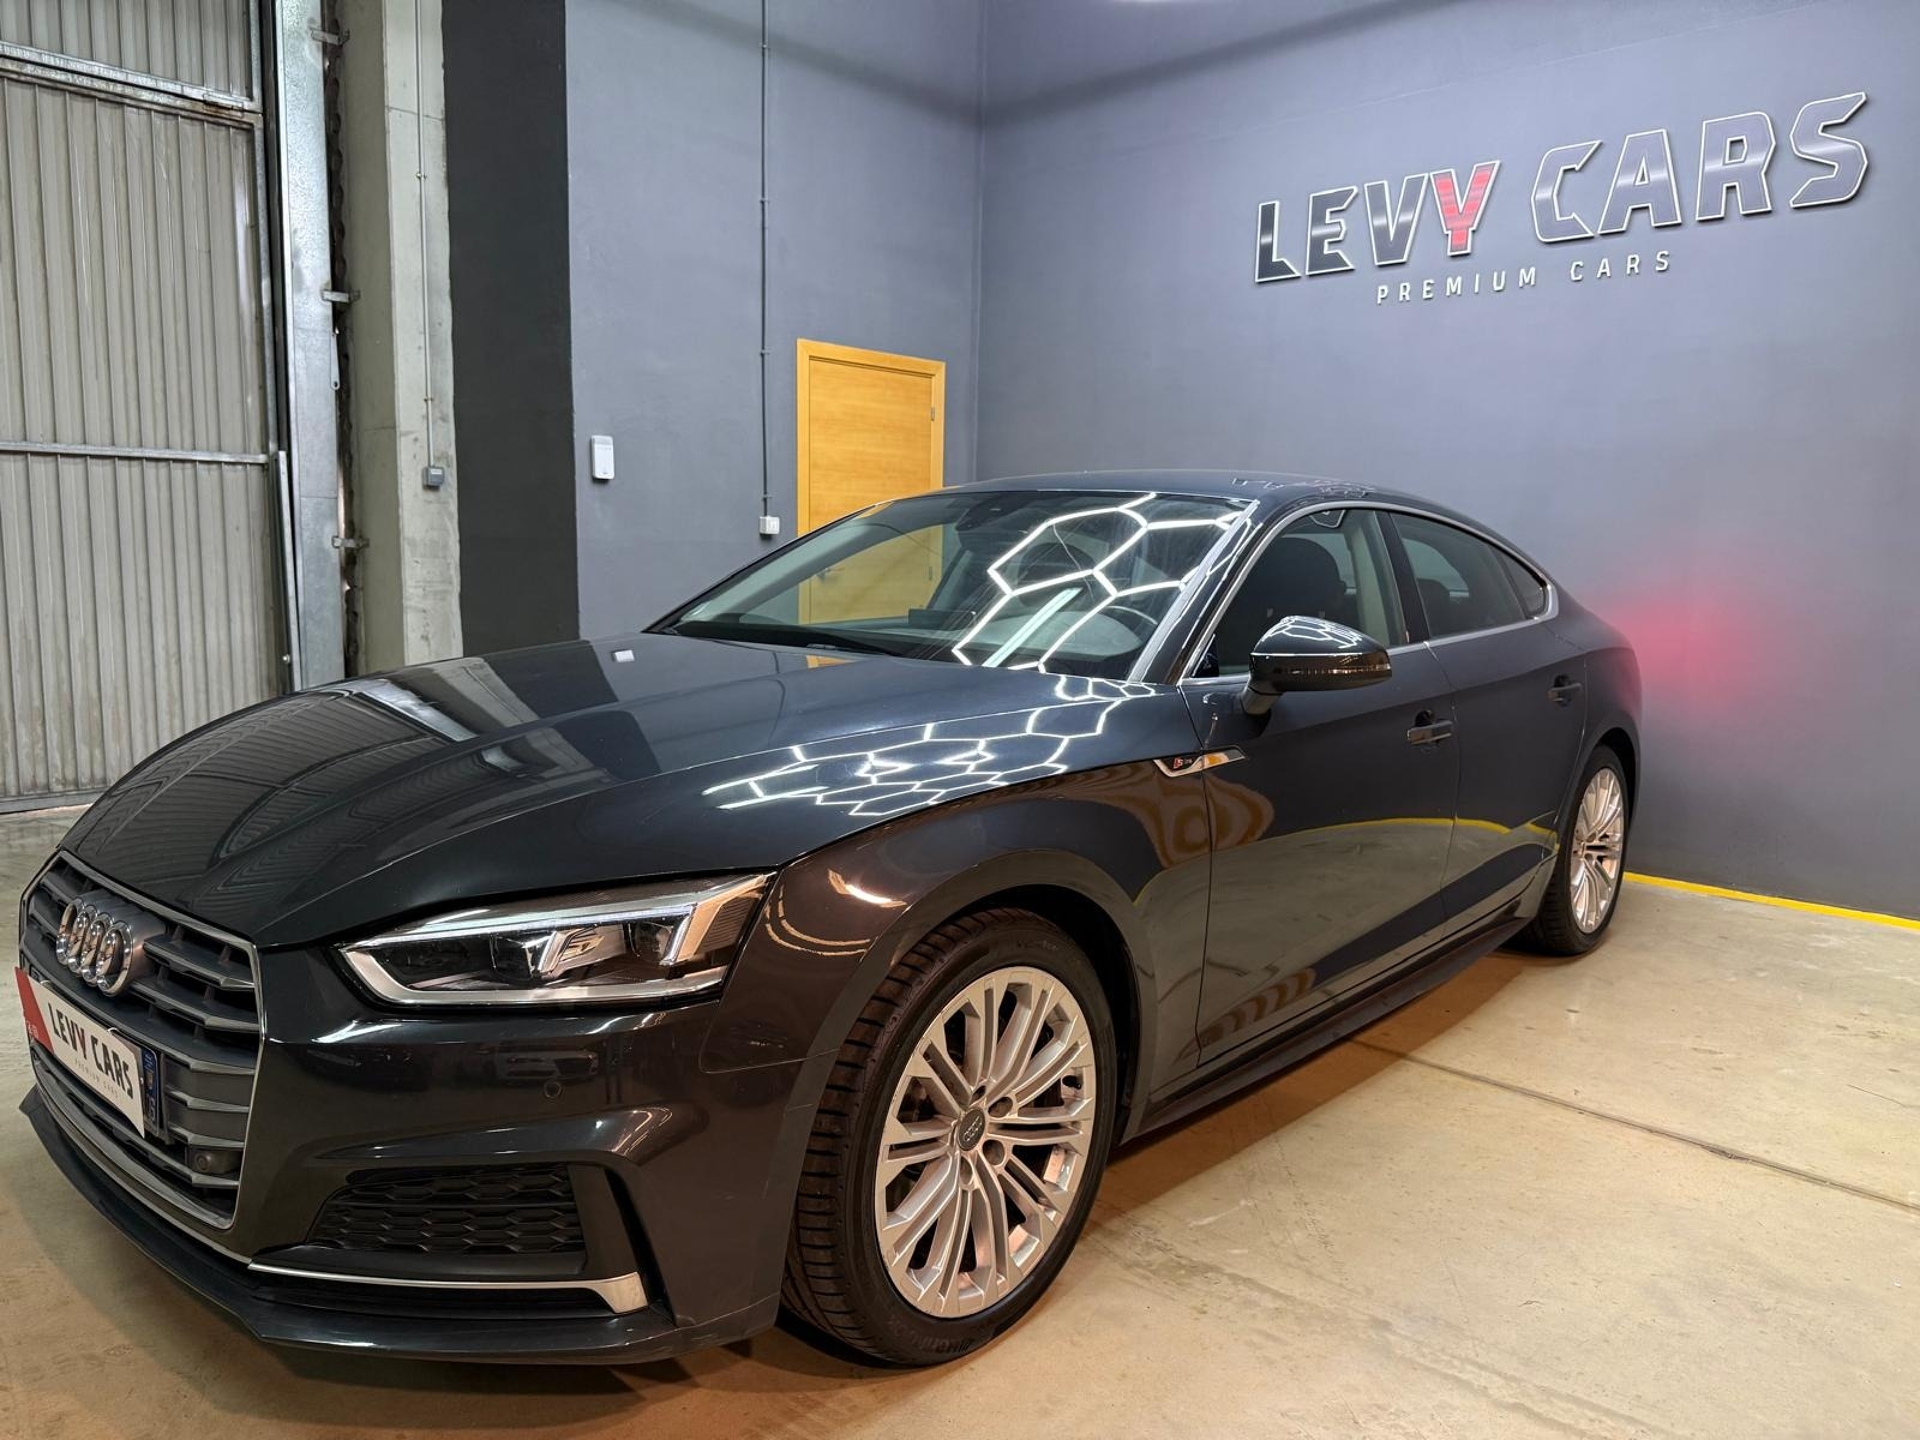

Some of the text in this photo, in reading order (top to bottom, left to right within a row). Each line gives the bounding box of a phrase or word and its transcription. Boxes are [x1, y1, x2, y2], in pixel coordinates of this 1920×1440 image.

[1254, 92, 1868, 283] LEVY CARS
[1377, 250, 1669, 304] PREMIUM CARS
[48, 1002, 87, 1060] LEVY
[90, 1035, 133, 1099] CARS
